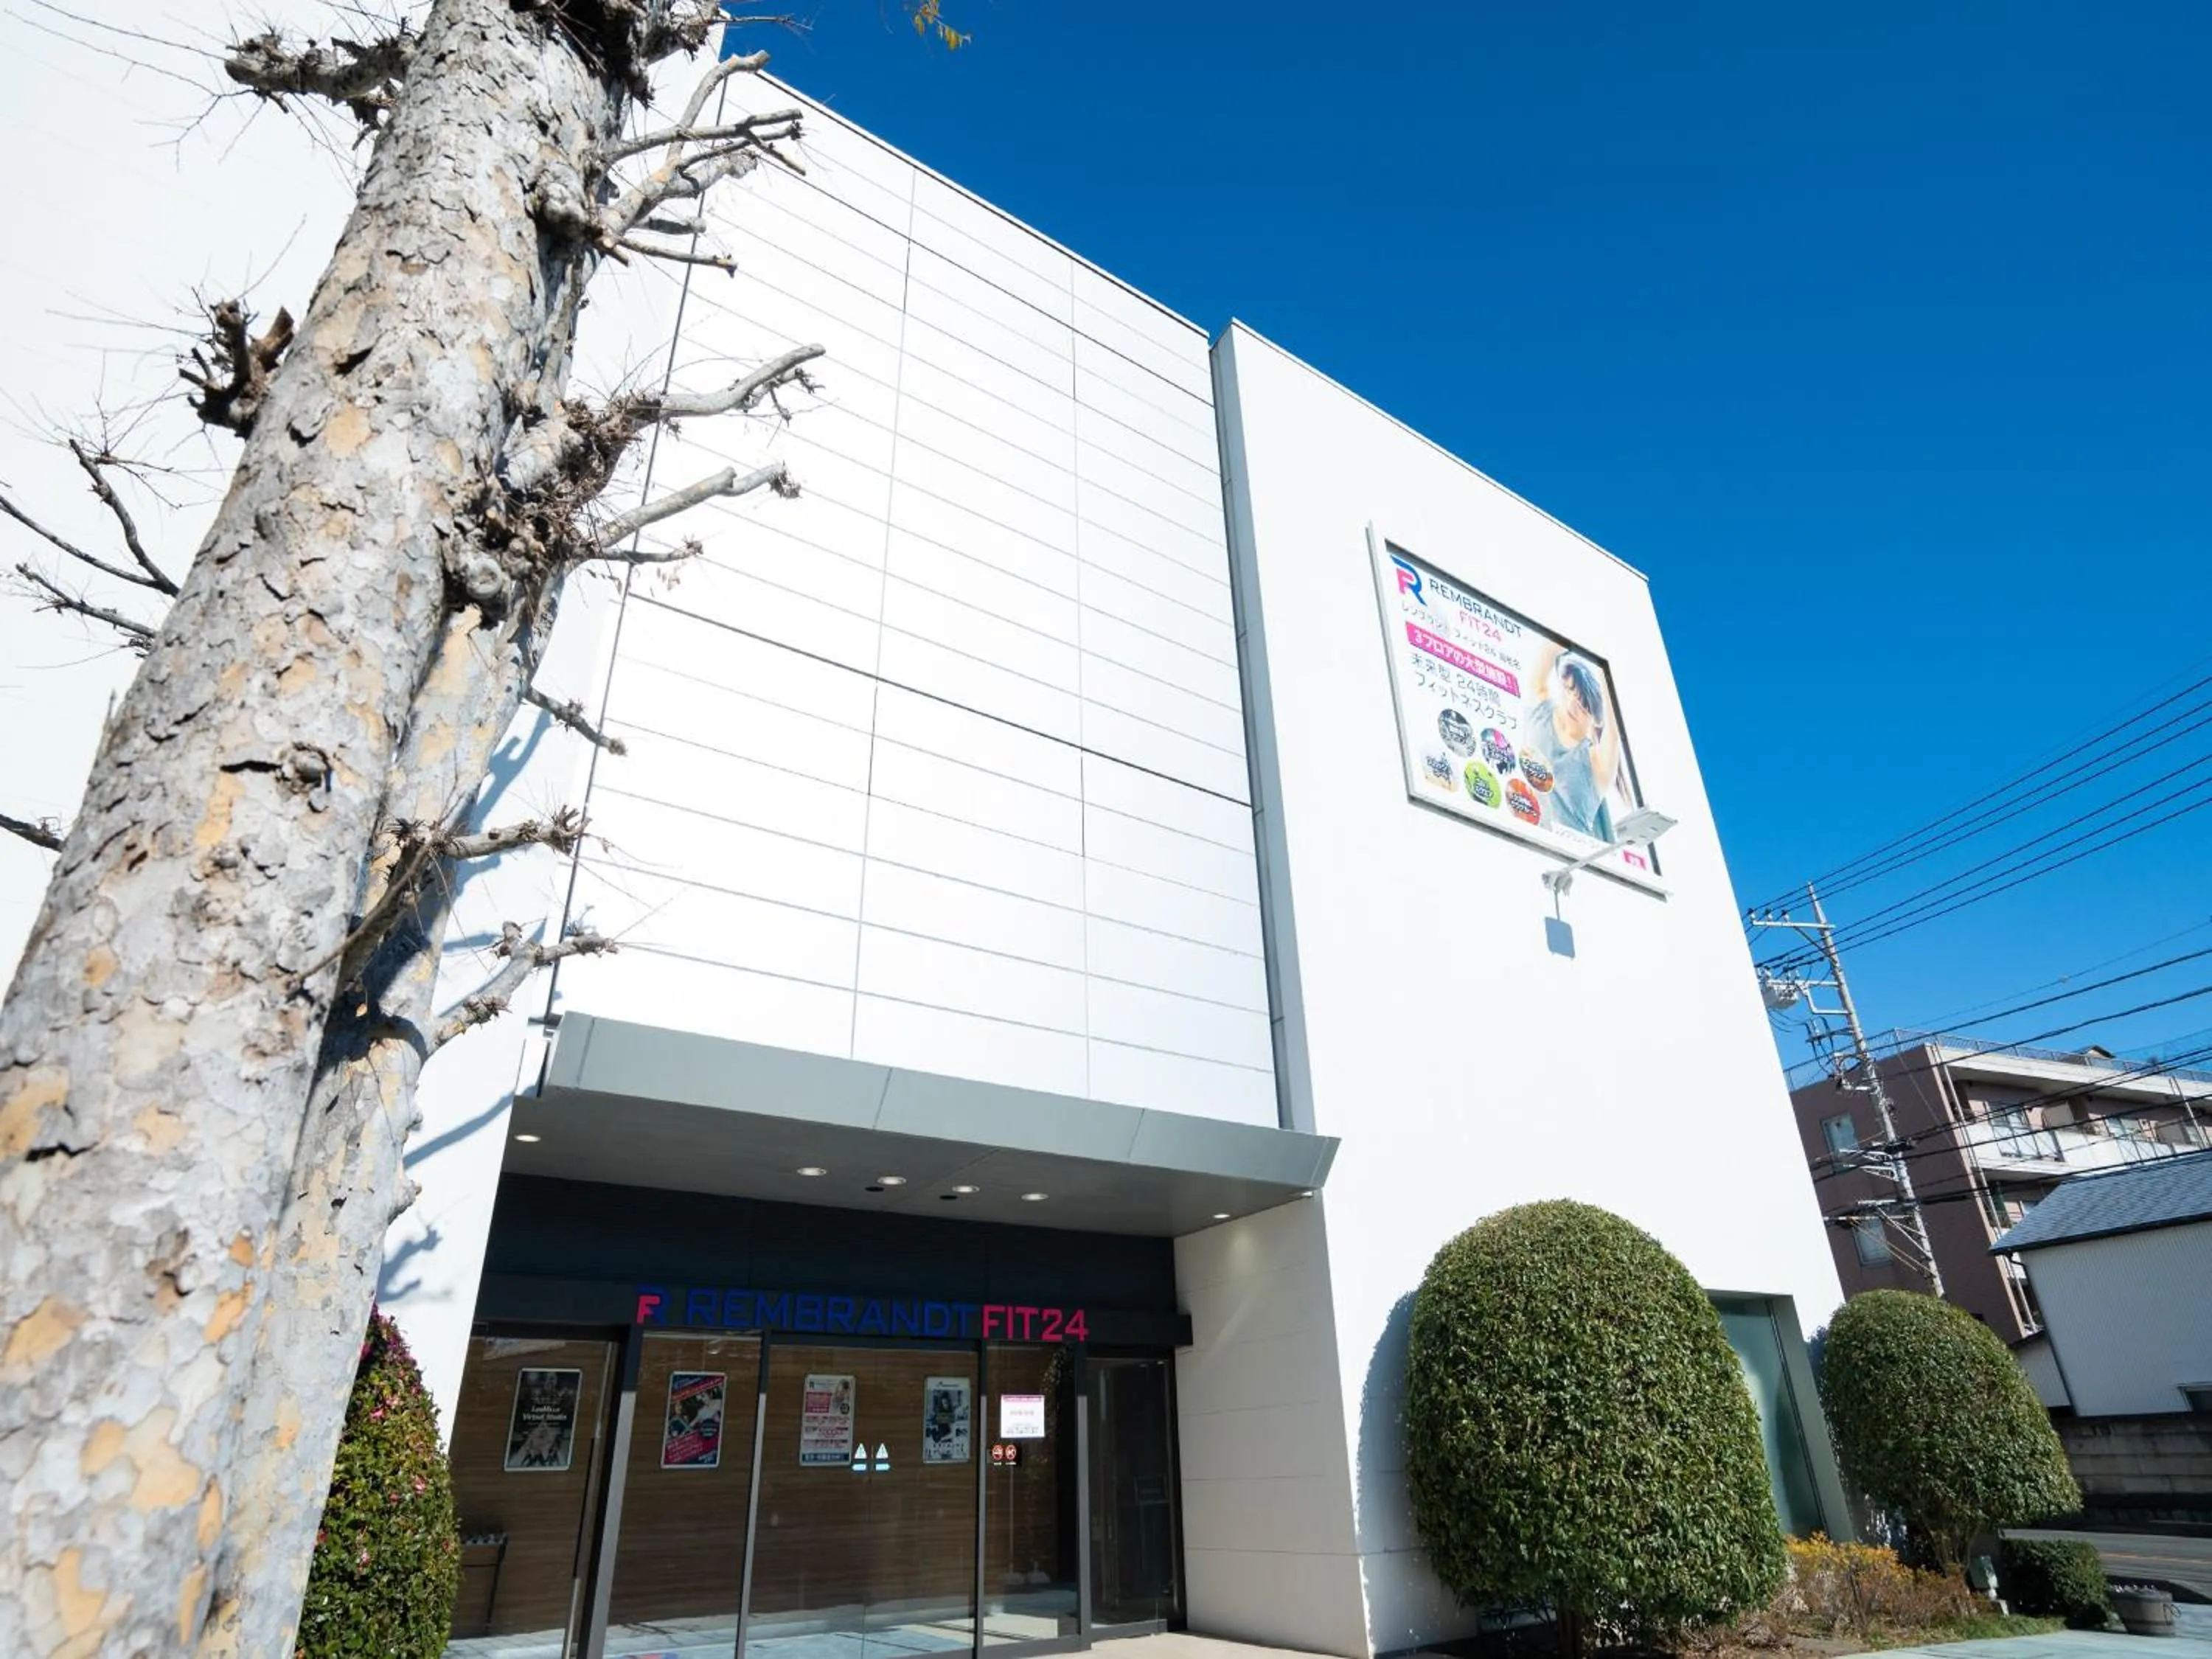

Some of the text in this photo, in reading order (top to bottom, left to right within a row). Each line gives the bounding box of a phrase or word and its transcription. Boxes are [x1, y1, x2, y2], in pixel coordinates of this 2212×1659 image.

[1429, 578, 1522, 637] REMBRANDT
[1459, 611, 1501, 642] FIT24
[686, 1288, 977, 1339] REMBRANDT
[982, 1304, 1089, 1342] FIT24
